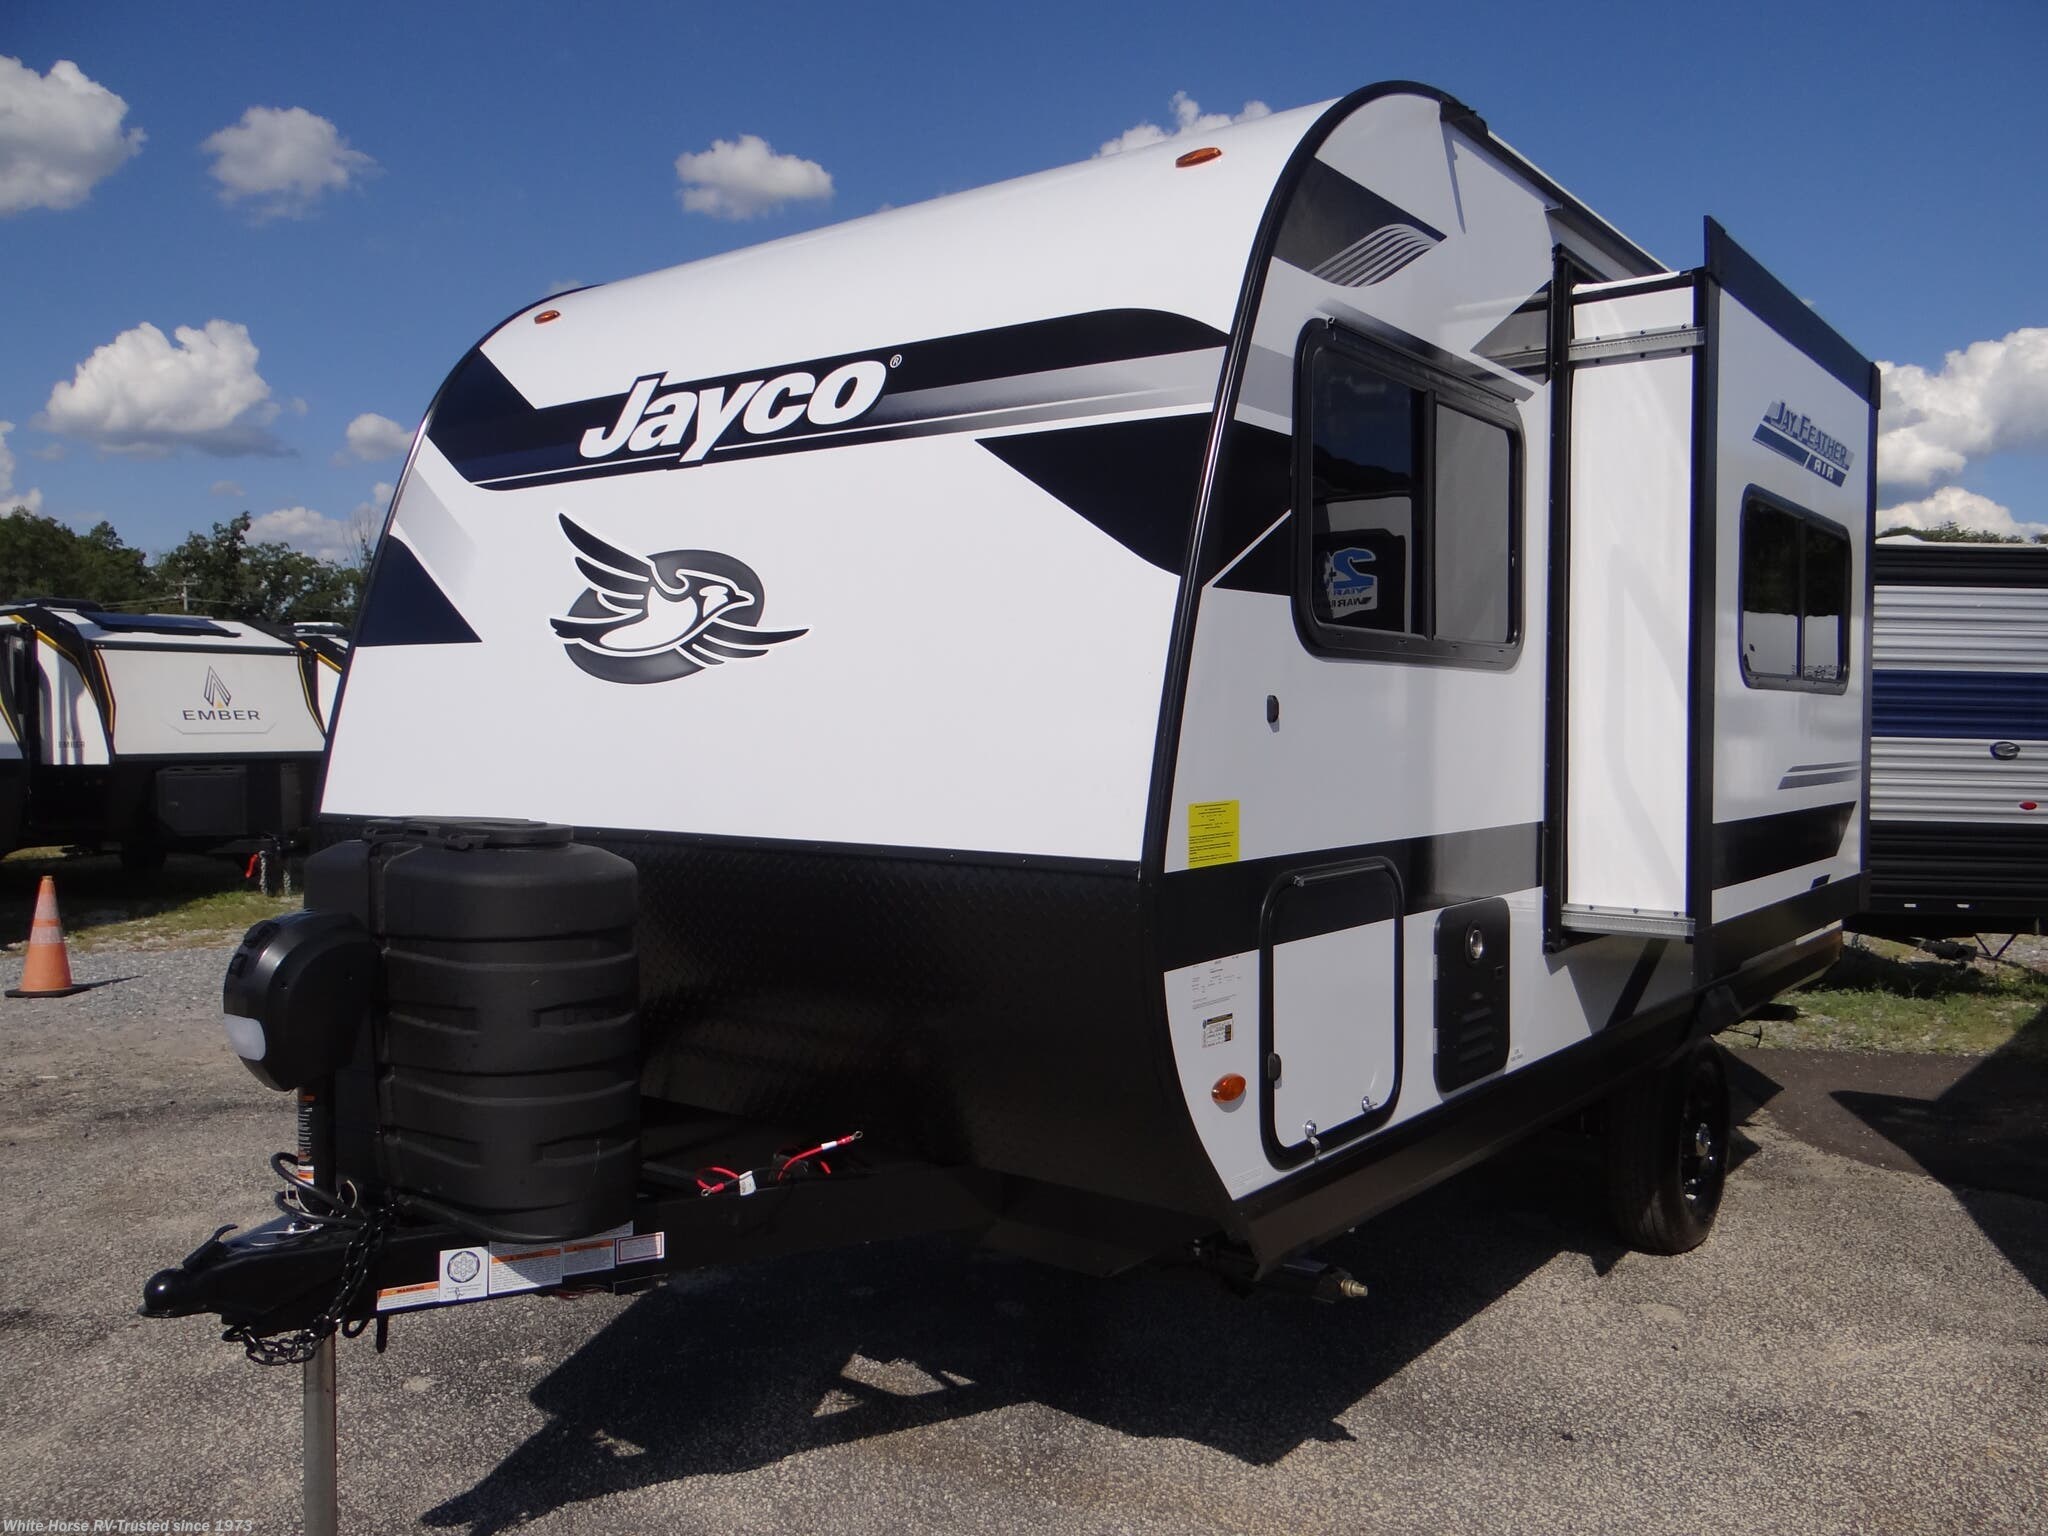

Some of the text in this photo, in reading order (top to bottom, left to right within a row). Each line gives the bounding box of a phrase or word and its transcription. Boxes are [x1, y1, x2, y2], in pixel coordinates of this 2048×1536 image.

[580, 360, 887, 463] Jayco
[1799, 415, 1848, 464] FEATHER
[1814, 459, 1834, 480] AIR
[182, 709, 260, 721] EMBER
